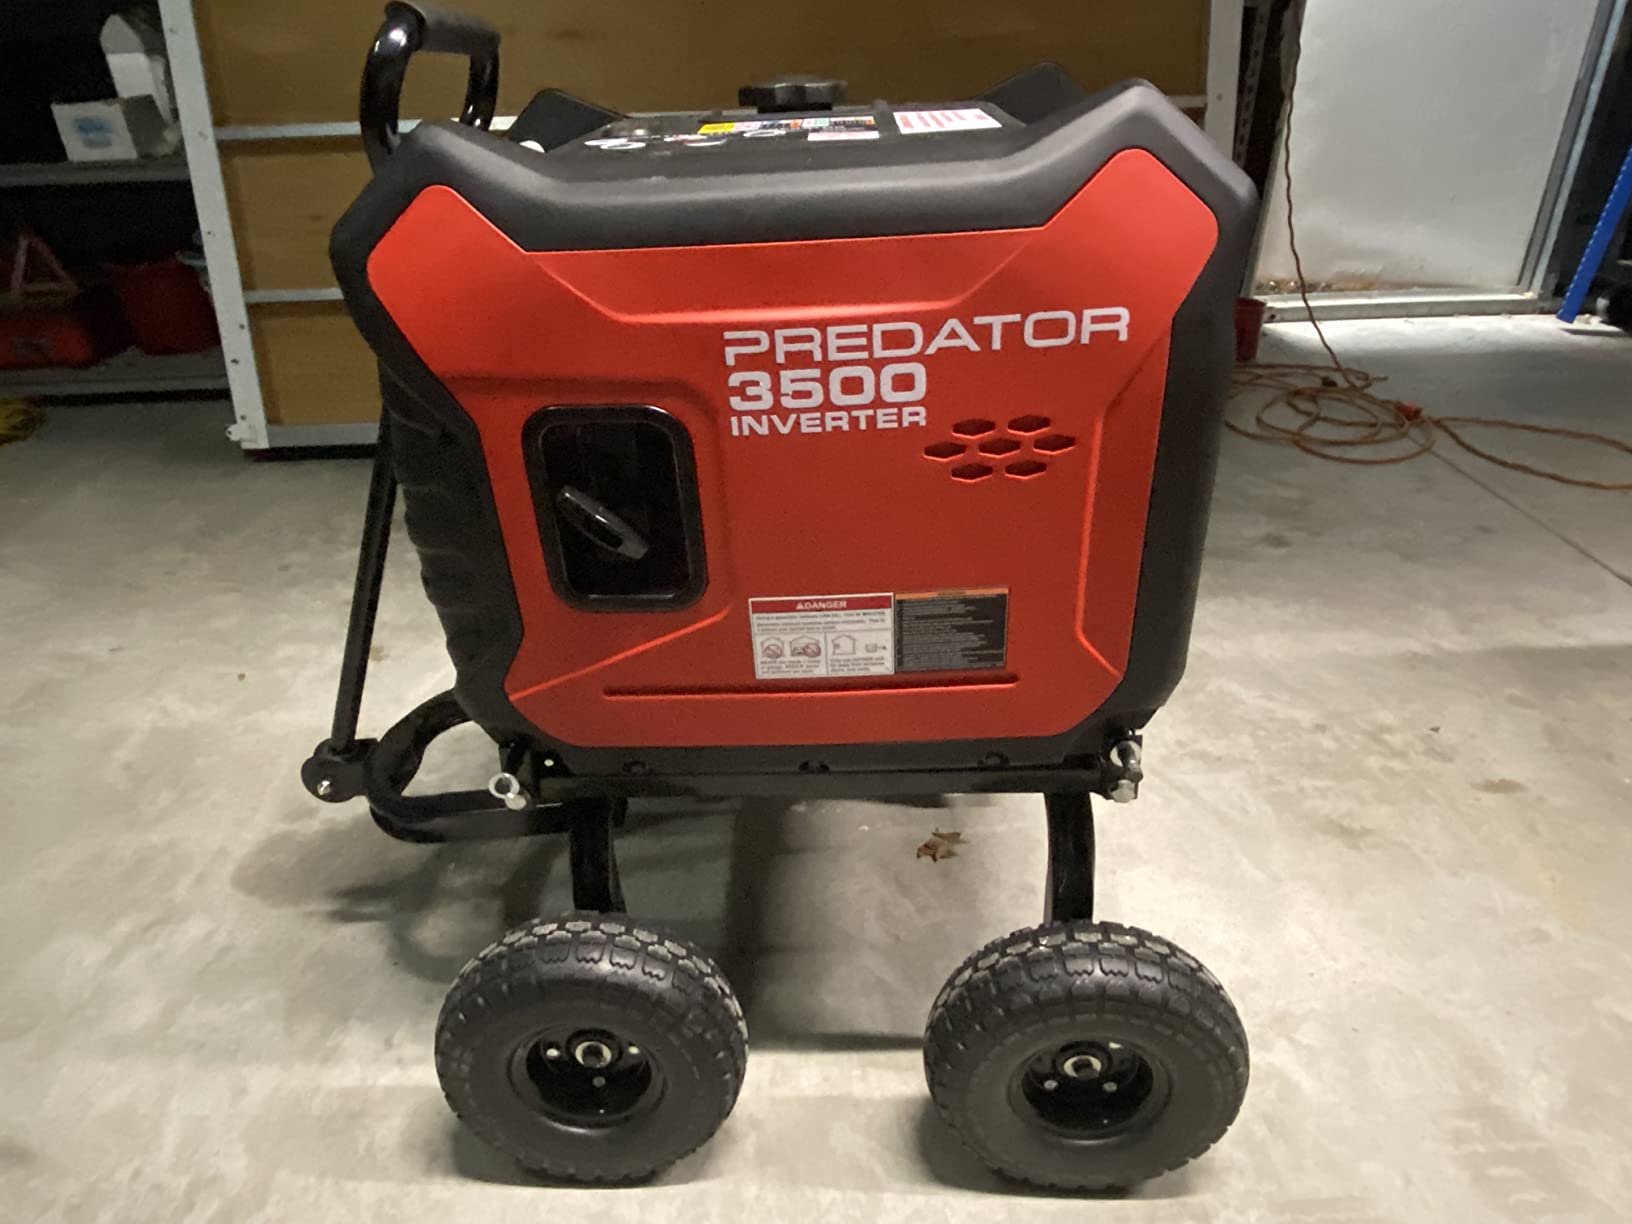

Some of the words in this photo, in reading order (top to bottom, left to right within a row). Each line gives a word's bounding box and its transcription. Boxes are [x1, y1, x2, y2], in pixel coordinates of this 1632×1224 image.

[723, 306, 1131, 367] PREDATOR
[728, 362, 927, 411] 3500
[731, 406, 927, 436] INVERTER
[804, 600, 847, 611] DANGER
